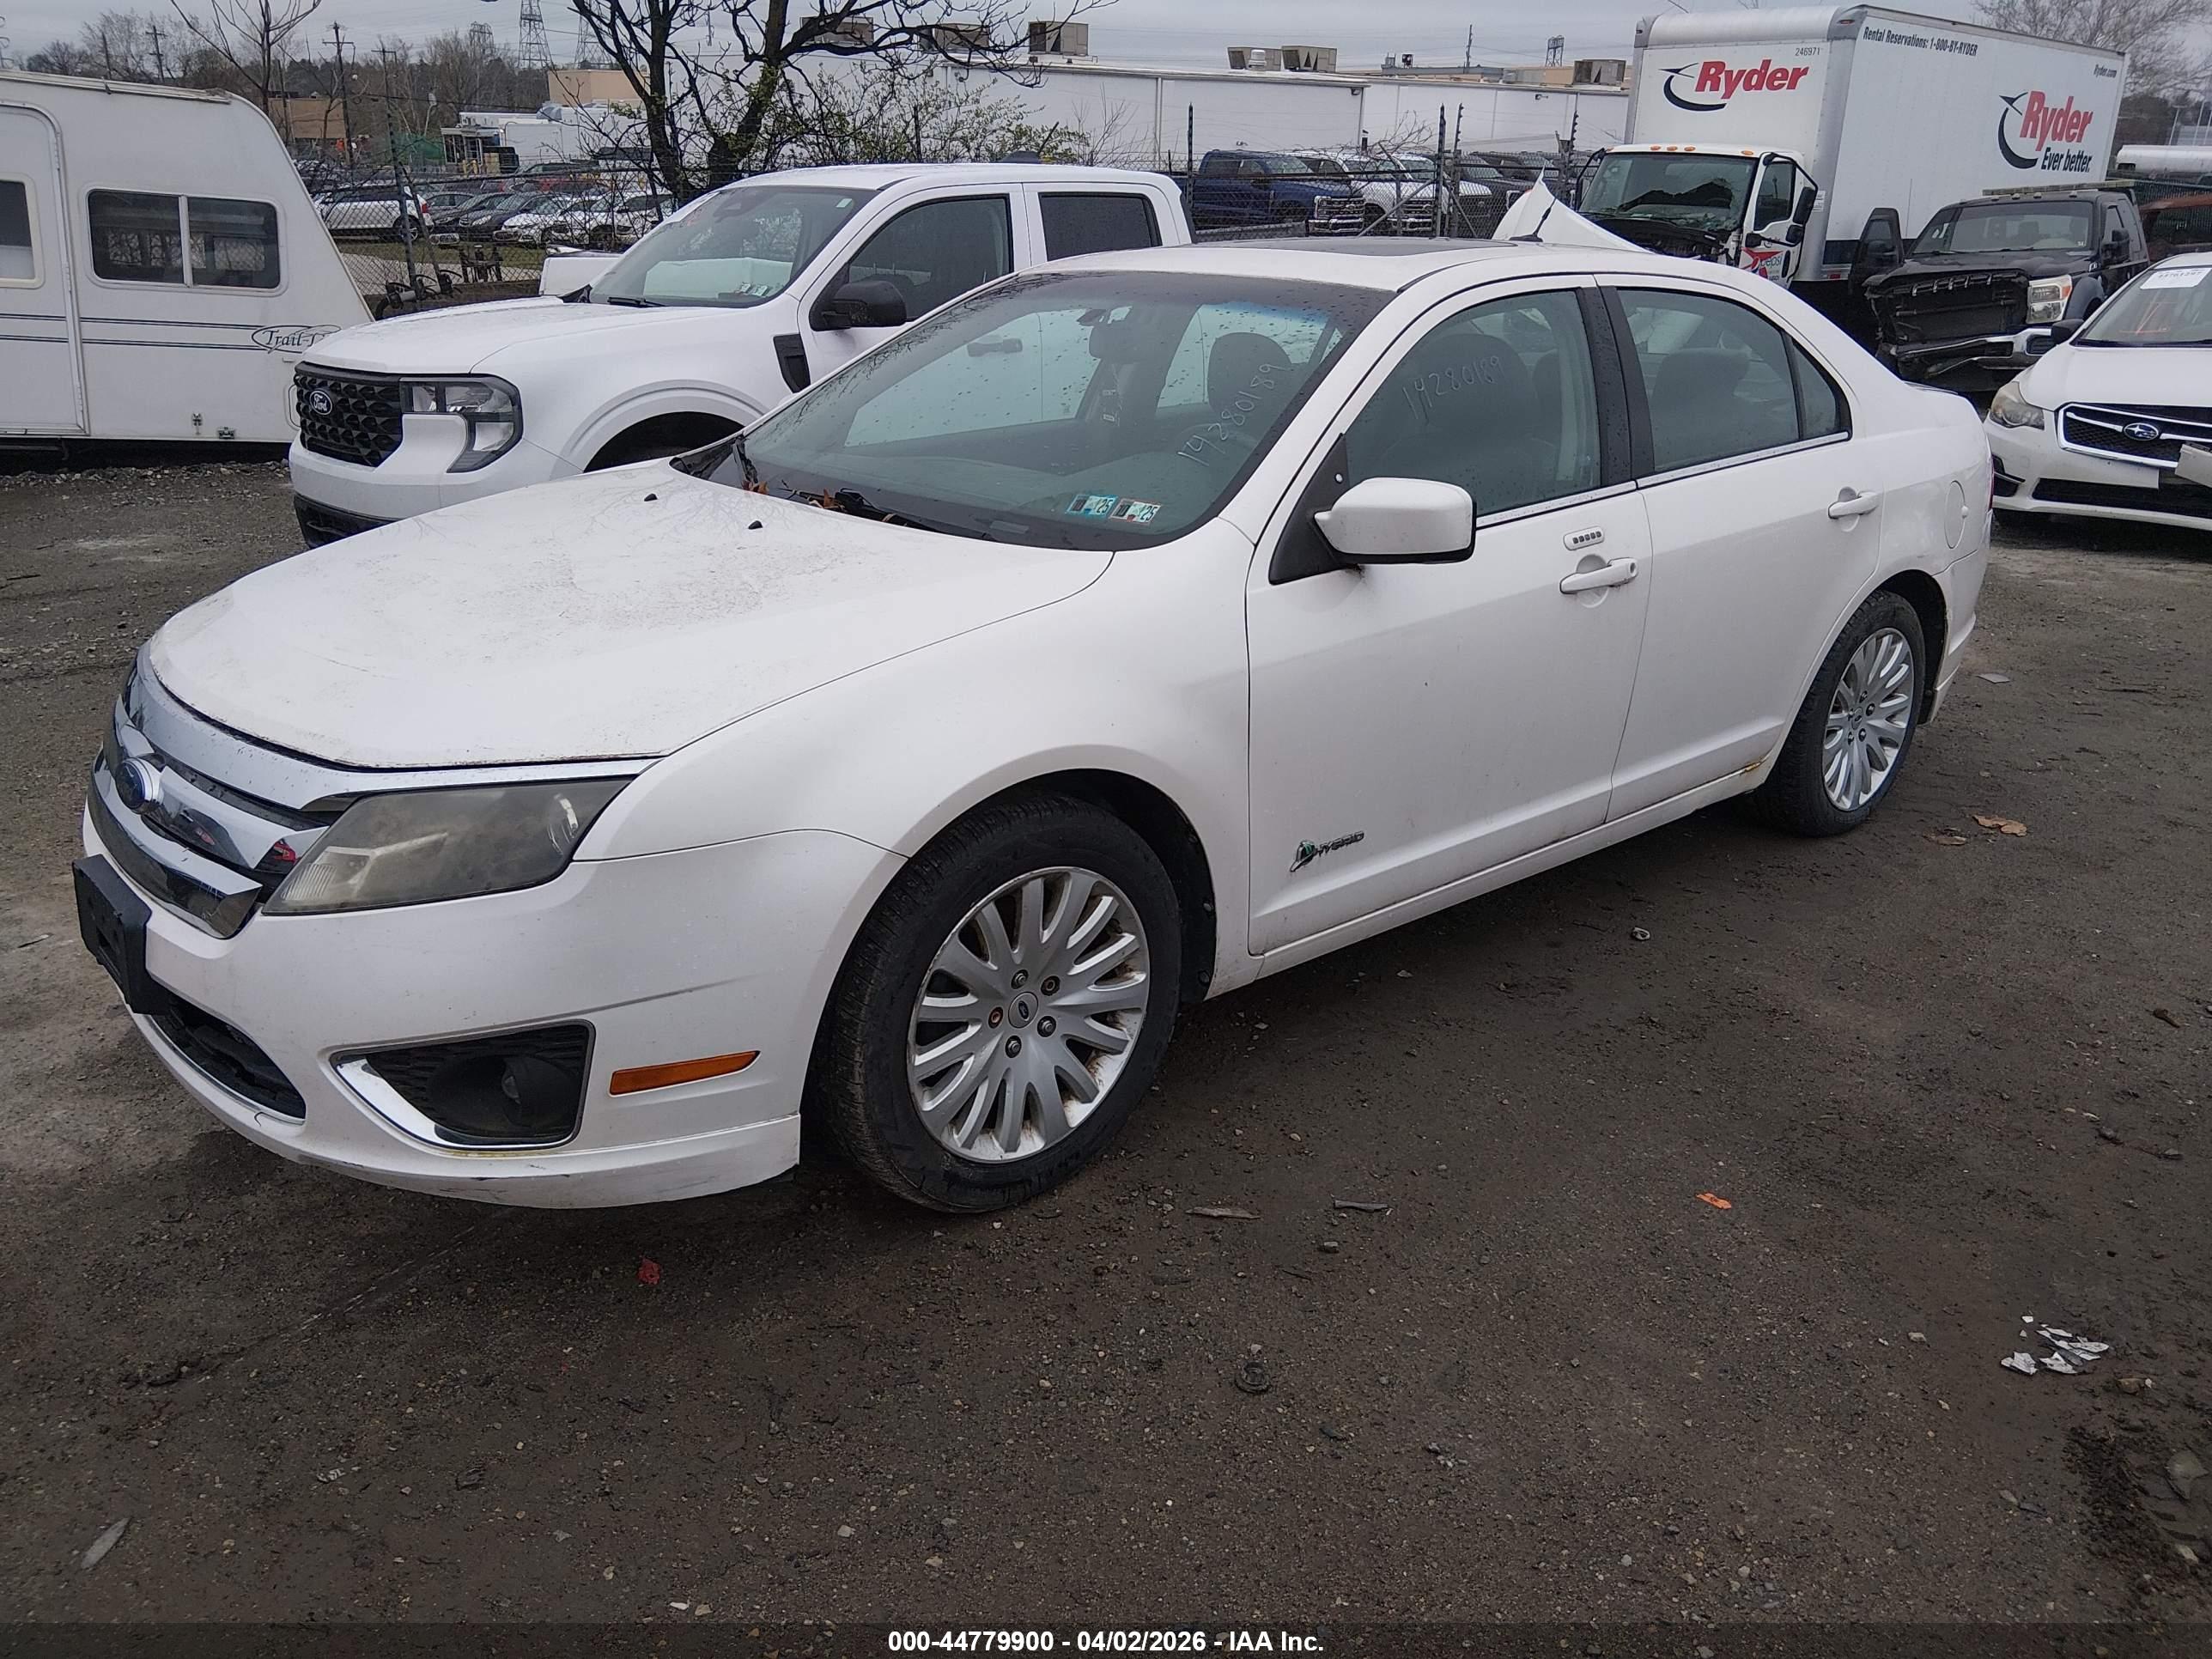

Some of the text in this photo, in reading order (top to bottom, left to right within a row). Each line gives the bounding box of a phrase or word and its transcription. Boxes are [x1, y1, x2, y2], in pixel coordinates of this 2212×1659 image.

[1795, 47, 1821, 56] 246971
[1863, 27, 1978, 57] Rental Reservations: 1-800-BY-RYDER
[1695, 59, 1809, 100] Ryder
[2094, 64, 2118, 78] Ryder.com
[2020, 91, 2094, 151] Ryder
[2041, 147, 2094, 173] Ever better.
[1177, 364, 1289, 466] 14280189
